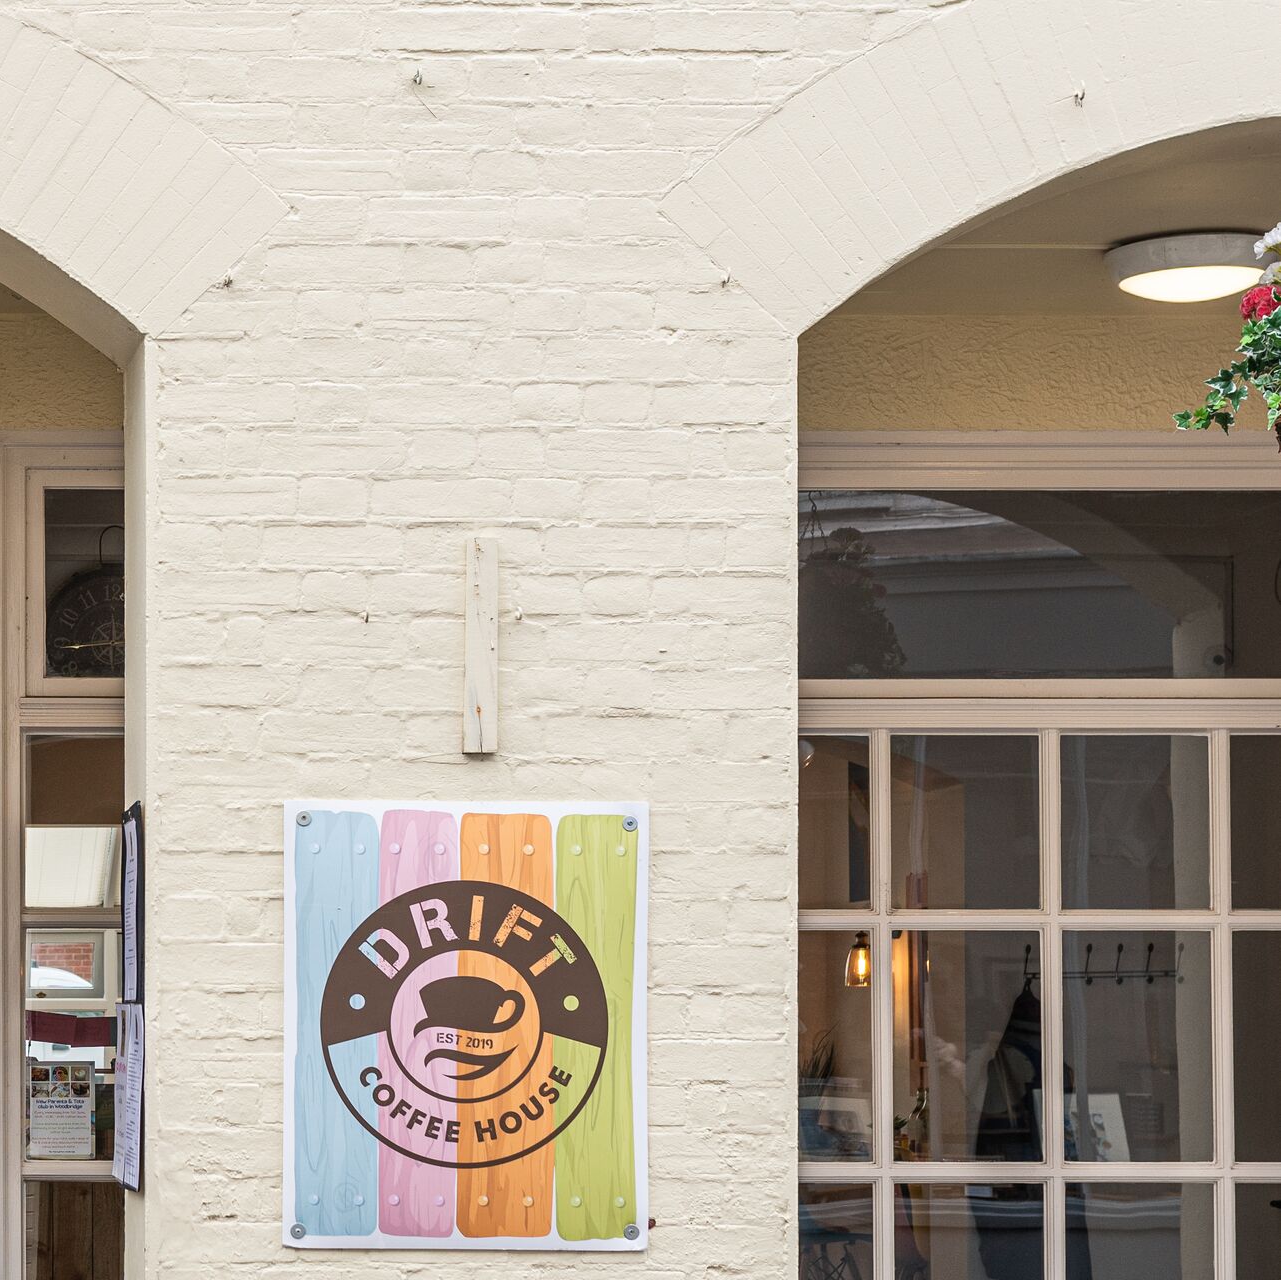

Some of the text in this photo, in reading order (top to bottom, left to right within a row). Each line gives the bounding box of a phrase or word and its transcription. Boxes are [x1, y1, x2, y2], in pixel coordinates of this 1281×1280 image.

[358, 895, 578, 980] DRIFT
[436, 1032, 494, 1049] EST 2019
[359, 1065, 573, 1143] COFFEE HOUSE
